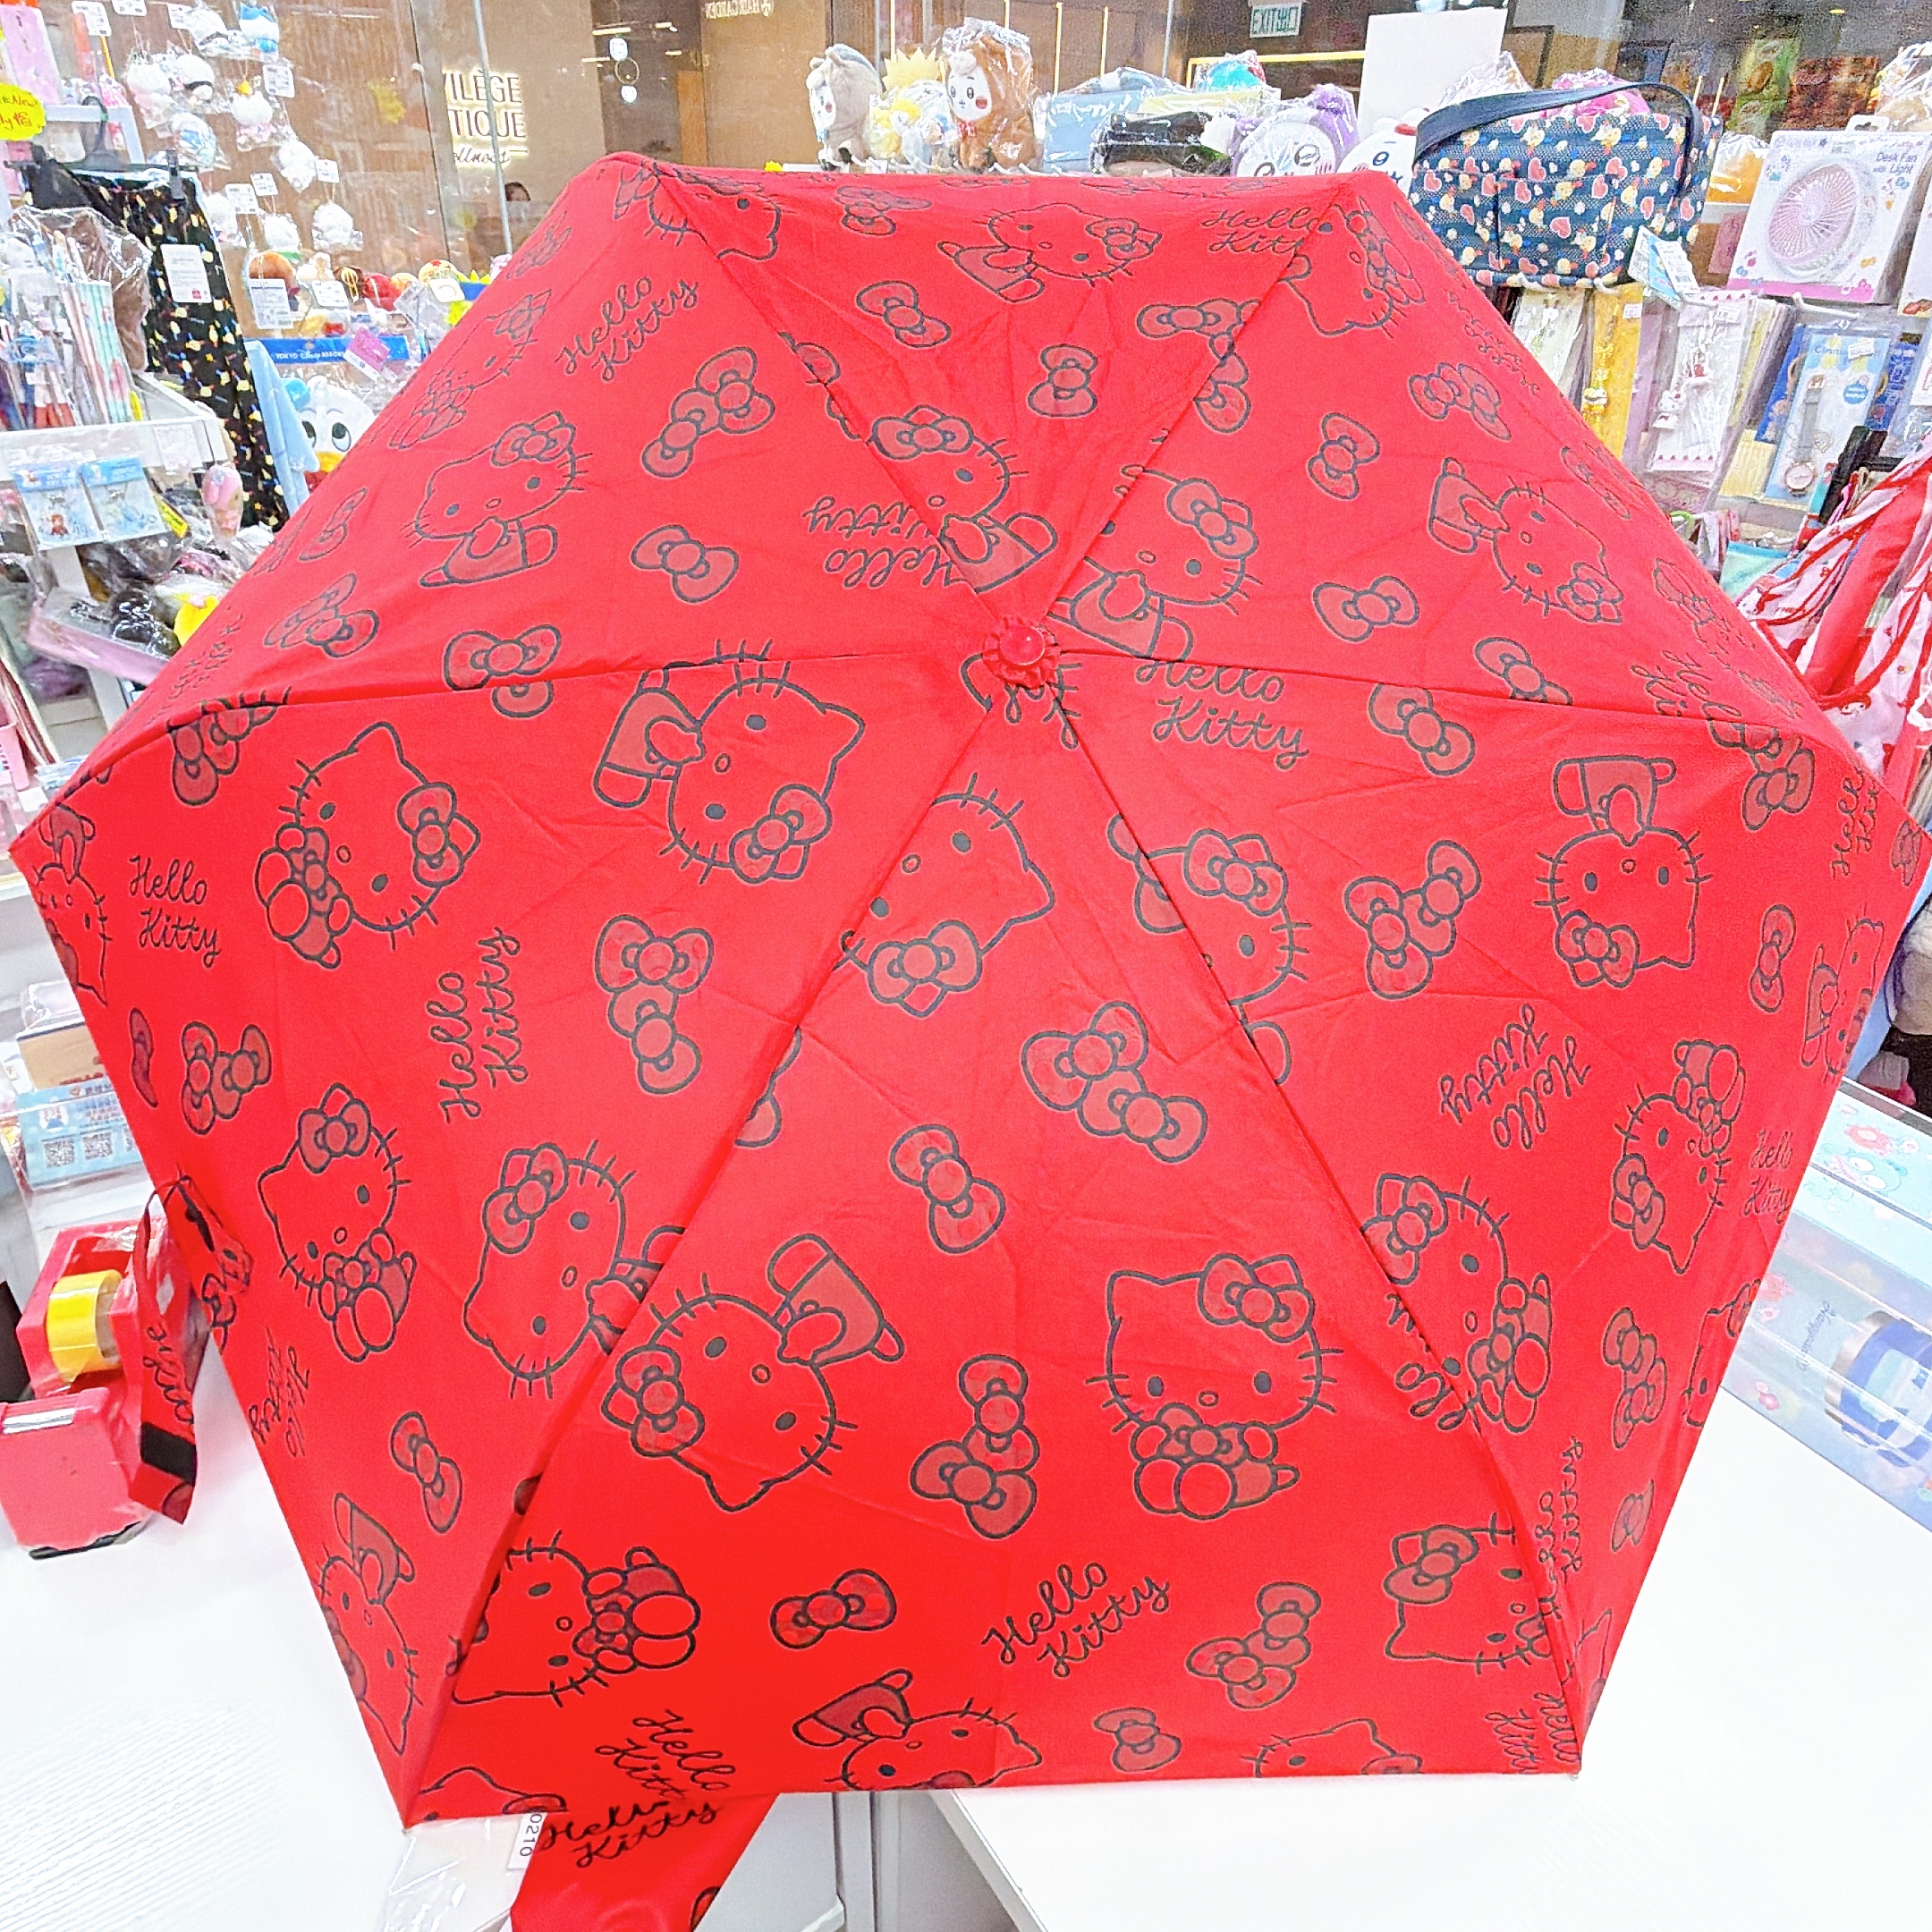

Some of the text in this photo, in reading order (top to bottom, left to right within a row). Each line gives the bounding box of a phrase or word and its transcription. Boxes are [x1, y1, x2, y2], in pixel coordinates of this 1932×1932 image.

[554, 276, 652, 375] Hello
[590, 279, 699, 381] Kitty
[825, 547, 968, 587] Hello
[1153, 696, 1309, 770] Kitty
[129, 854, 208, 905] Hello
[139, 907, 222, 968] Kitty
[426, 970, 482, 1124] Hello
[475, 926, 529, 1089] Kitty
[1439, 1004, 1550, 1124] Kitty
[1492, 1036, 1592, 1150] Hello
[1750, 1129, 1793, 1170] Hello
[1742, 1175, 1791, 1224] Kitty
[1559, 1435, 1584, 1586] Kitty
[981, 1562, 1108, 1665] Hello
[1037, 1576, 1171, 1678] Kitty
[631, 1709, 733, 1791] Hello
[520, 1813, 543, 1857] 0210
[573, 1801, 724, 1868] Kitty
